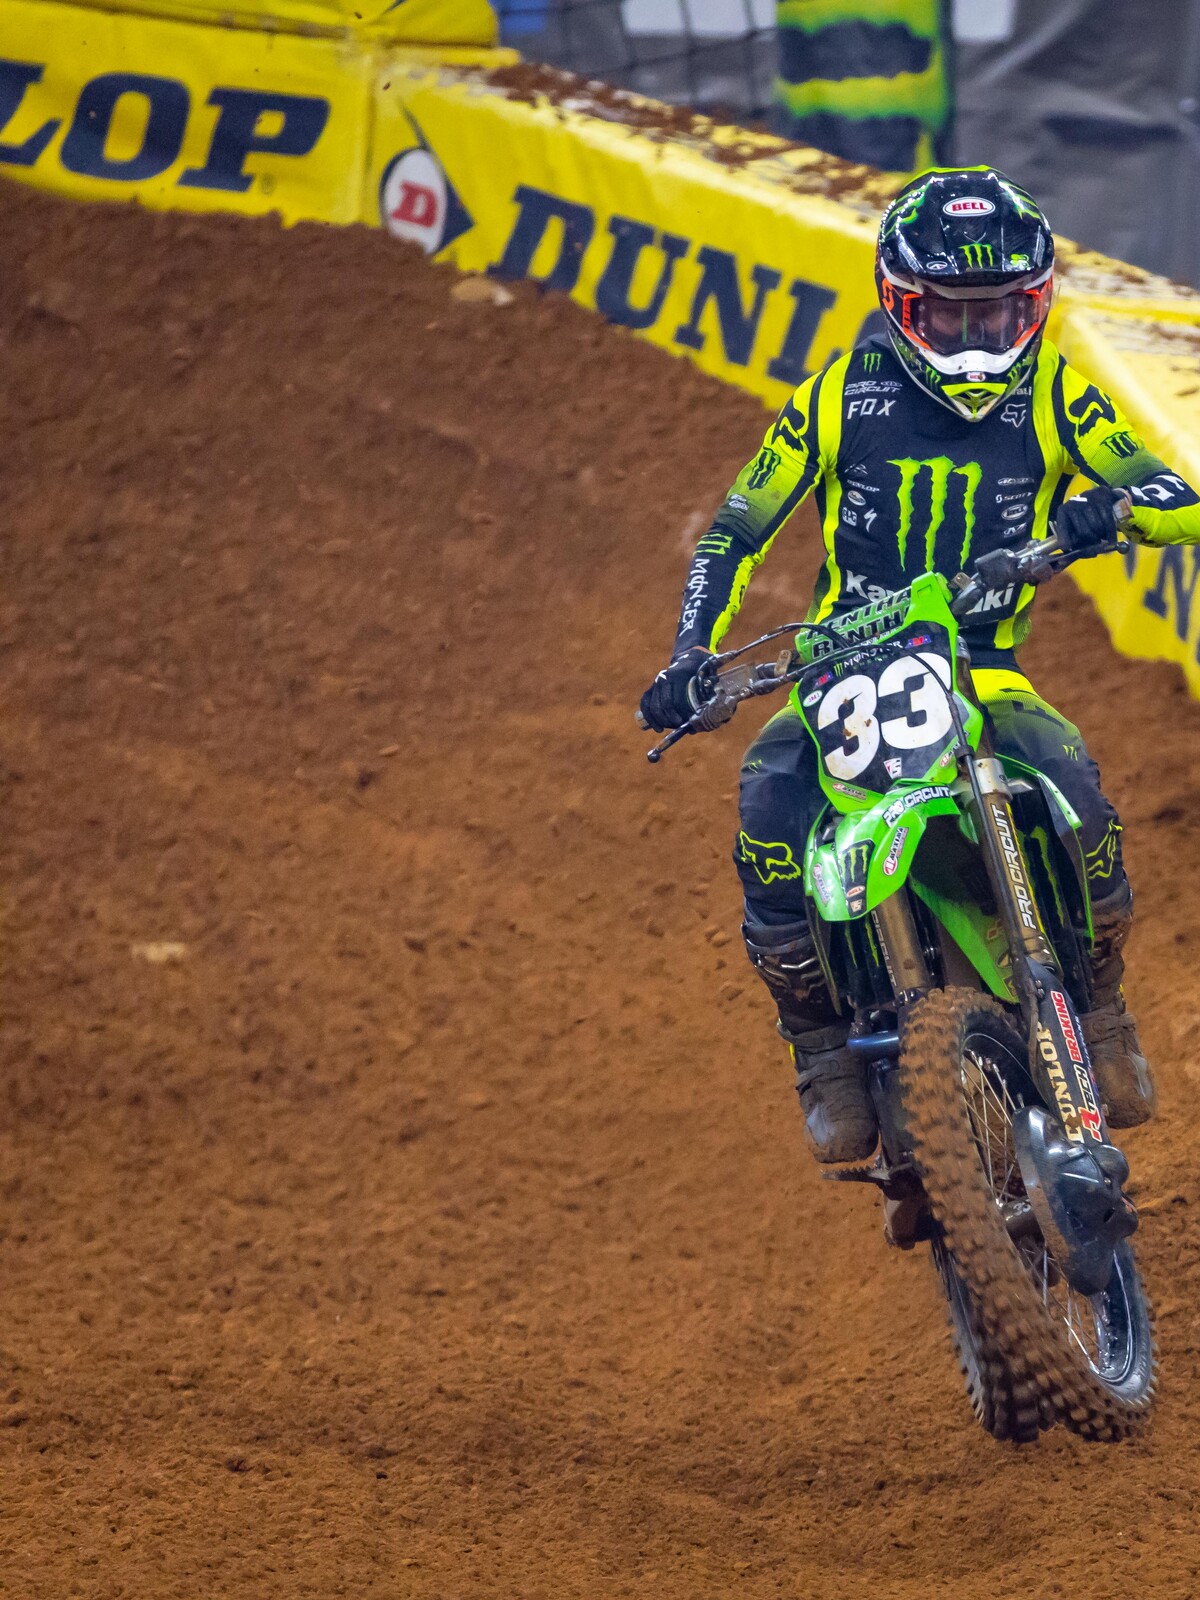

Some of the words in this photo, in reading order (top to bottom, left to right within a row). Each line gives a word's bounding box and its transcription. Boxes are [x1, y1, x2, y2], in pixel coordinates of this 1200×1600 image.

[952, 202, 988, 212] BELL
[847, 399, 896, 420] FOX
[847, 479, 880, 493] DUNLOP
[817, 652, 954, 781] 33
[904, 786, 951, 808] CIRCUIT
[991, 803, 1025, 882] CIRCUIT
[1014, 879, 1037, 930] PRO
[1050, 990, 1084, 1064] BRAKING
